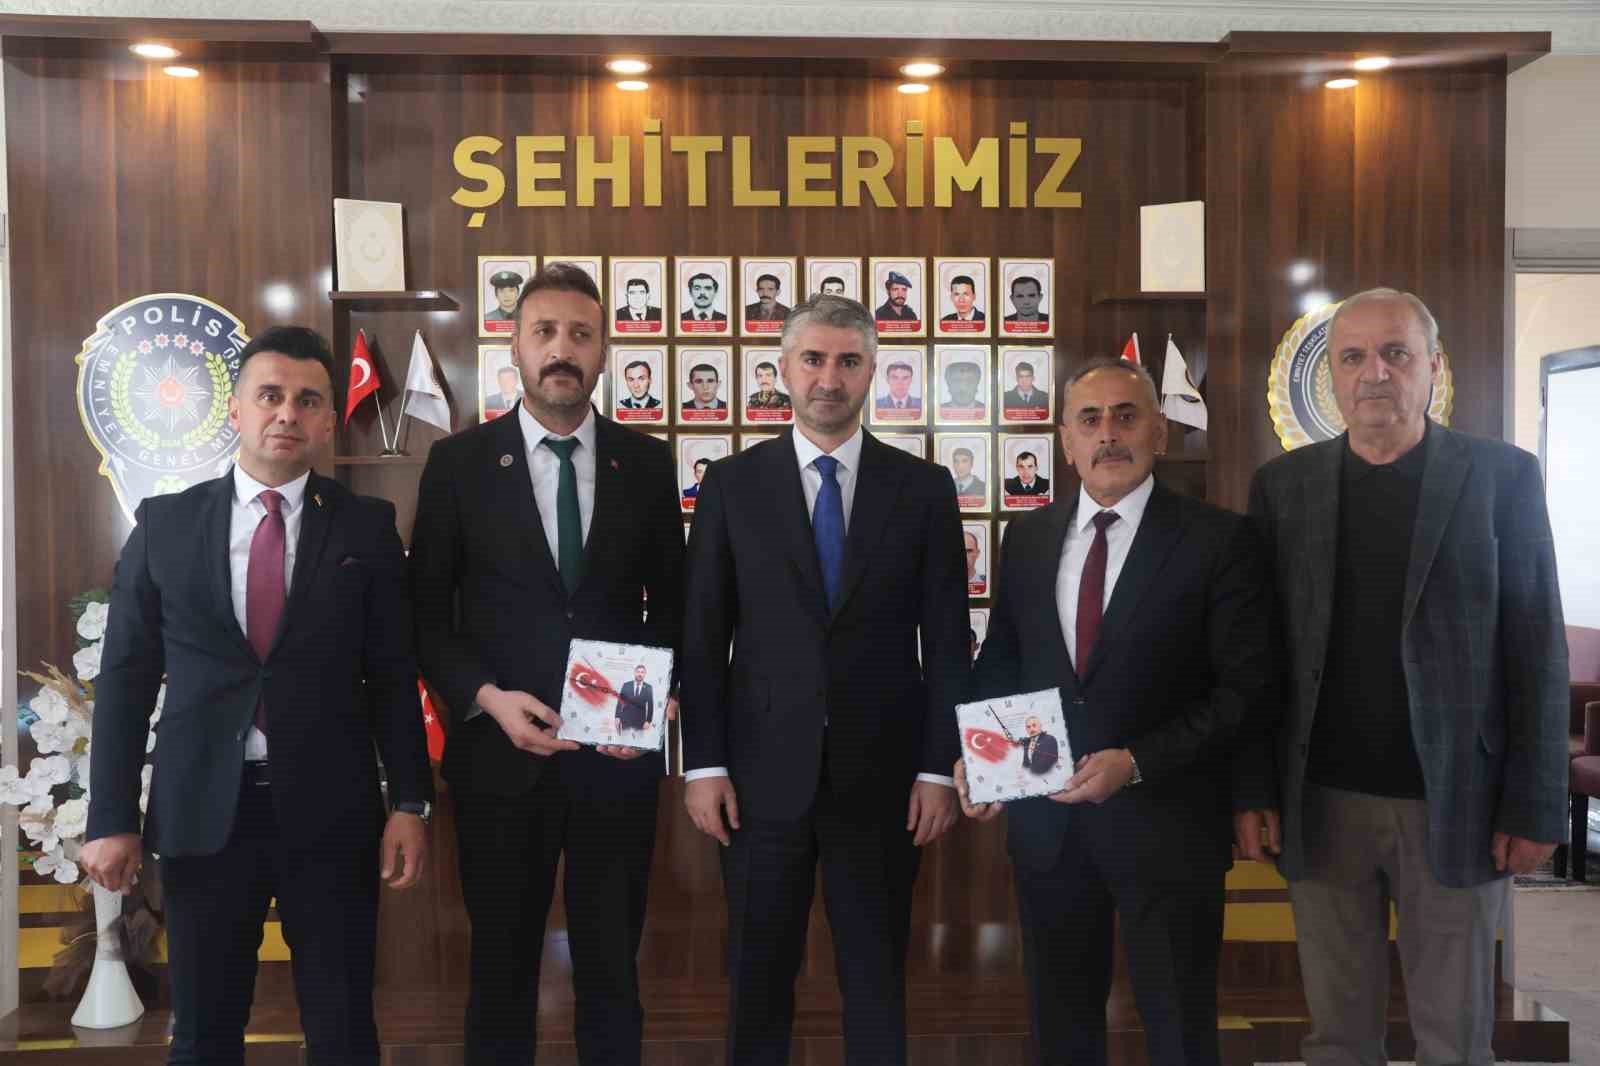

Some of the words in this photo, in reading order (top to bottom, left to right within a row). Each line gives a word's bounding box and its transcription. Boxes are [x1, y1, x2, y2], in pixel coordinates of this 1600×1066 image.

[450, 118, 1083, 228] ŞEHİTLERİMİZ
[120, 305, 222, 337] POLİS
[138, 451, 203, 466] GENEL
